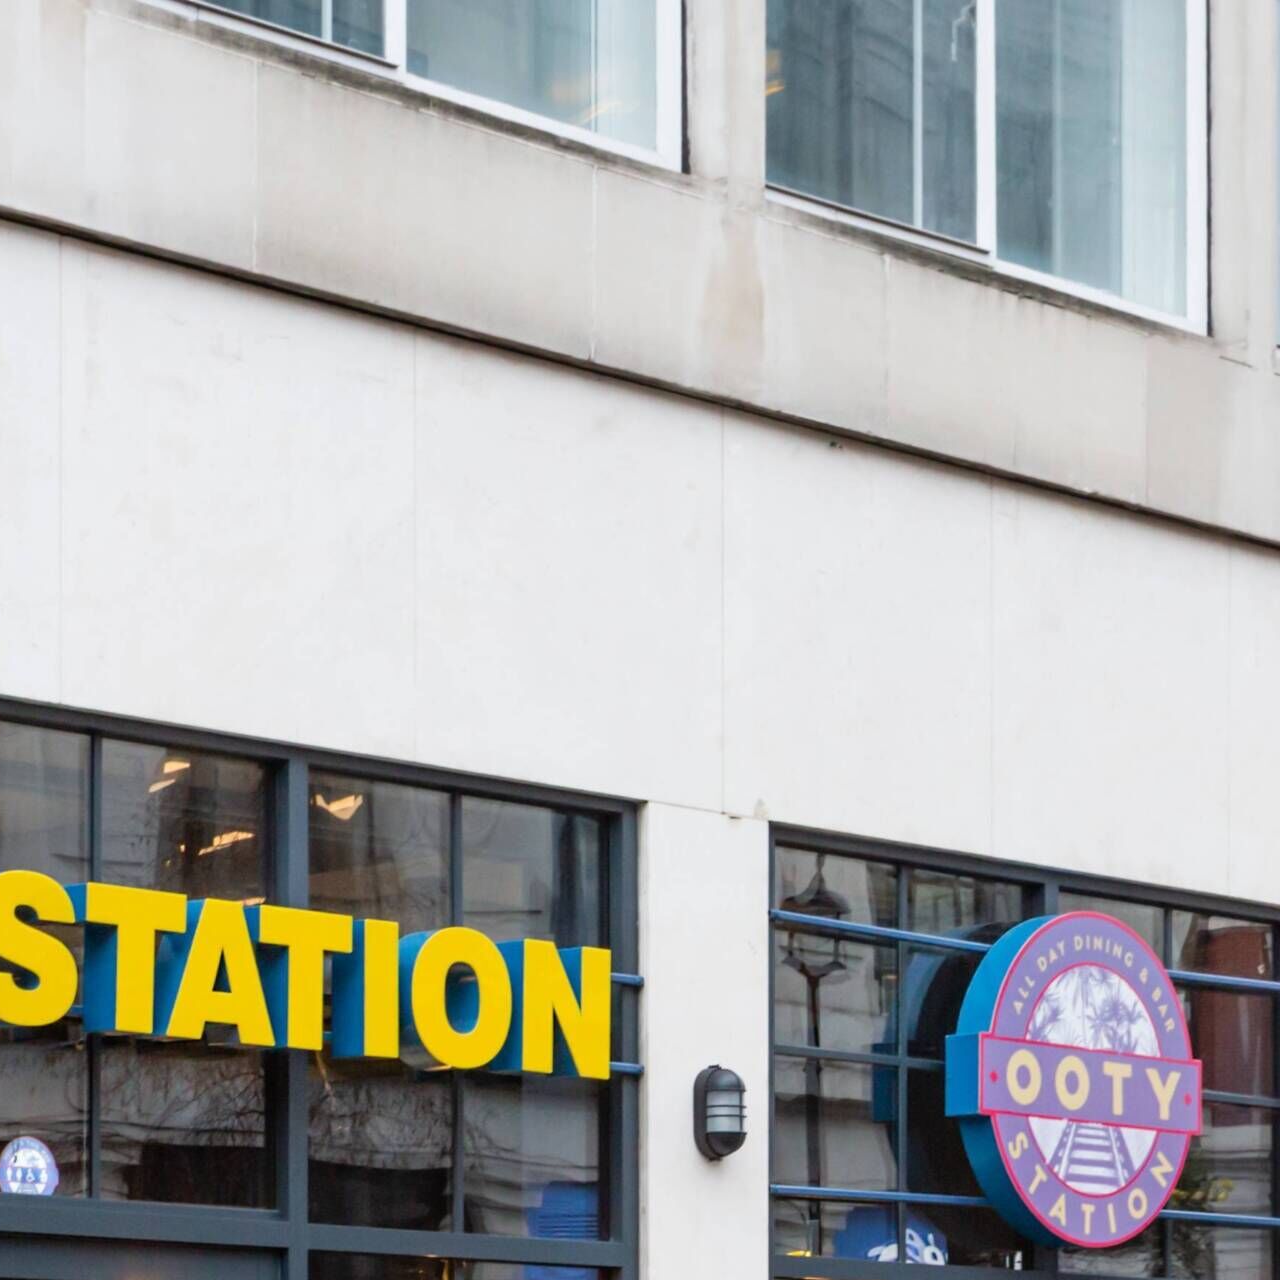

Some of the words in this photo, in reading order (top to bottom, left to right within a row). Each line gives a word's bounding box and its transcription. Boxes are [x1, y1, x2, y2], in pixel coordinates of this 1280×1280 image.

[1013, 974, 1036, 1015] ALL
[1036, 943, 1067, 973] DAY
[1074, 935, 1134, 968] DINING
[1138, 967, 1149, 985] &
[1152, 986, 1176, 1033] BAR
[1005, 1048, 1182, 1121] OOTY
[1008, 1131, 1174, 1236] STATION
